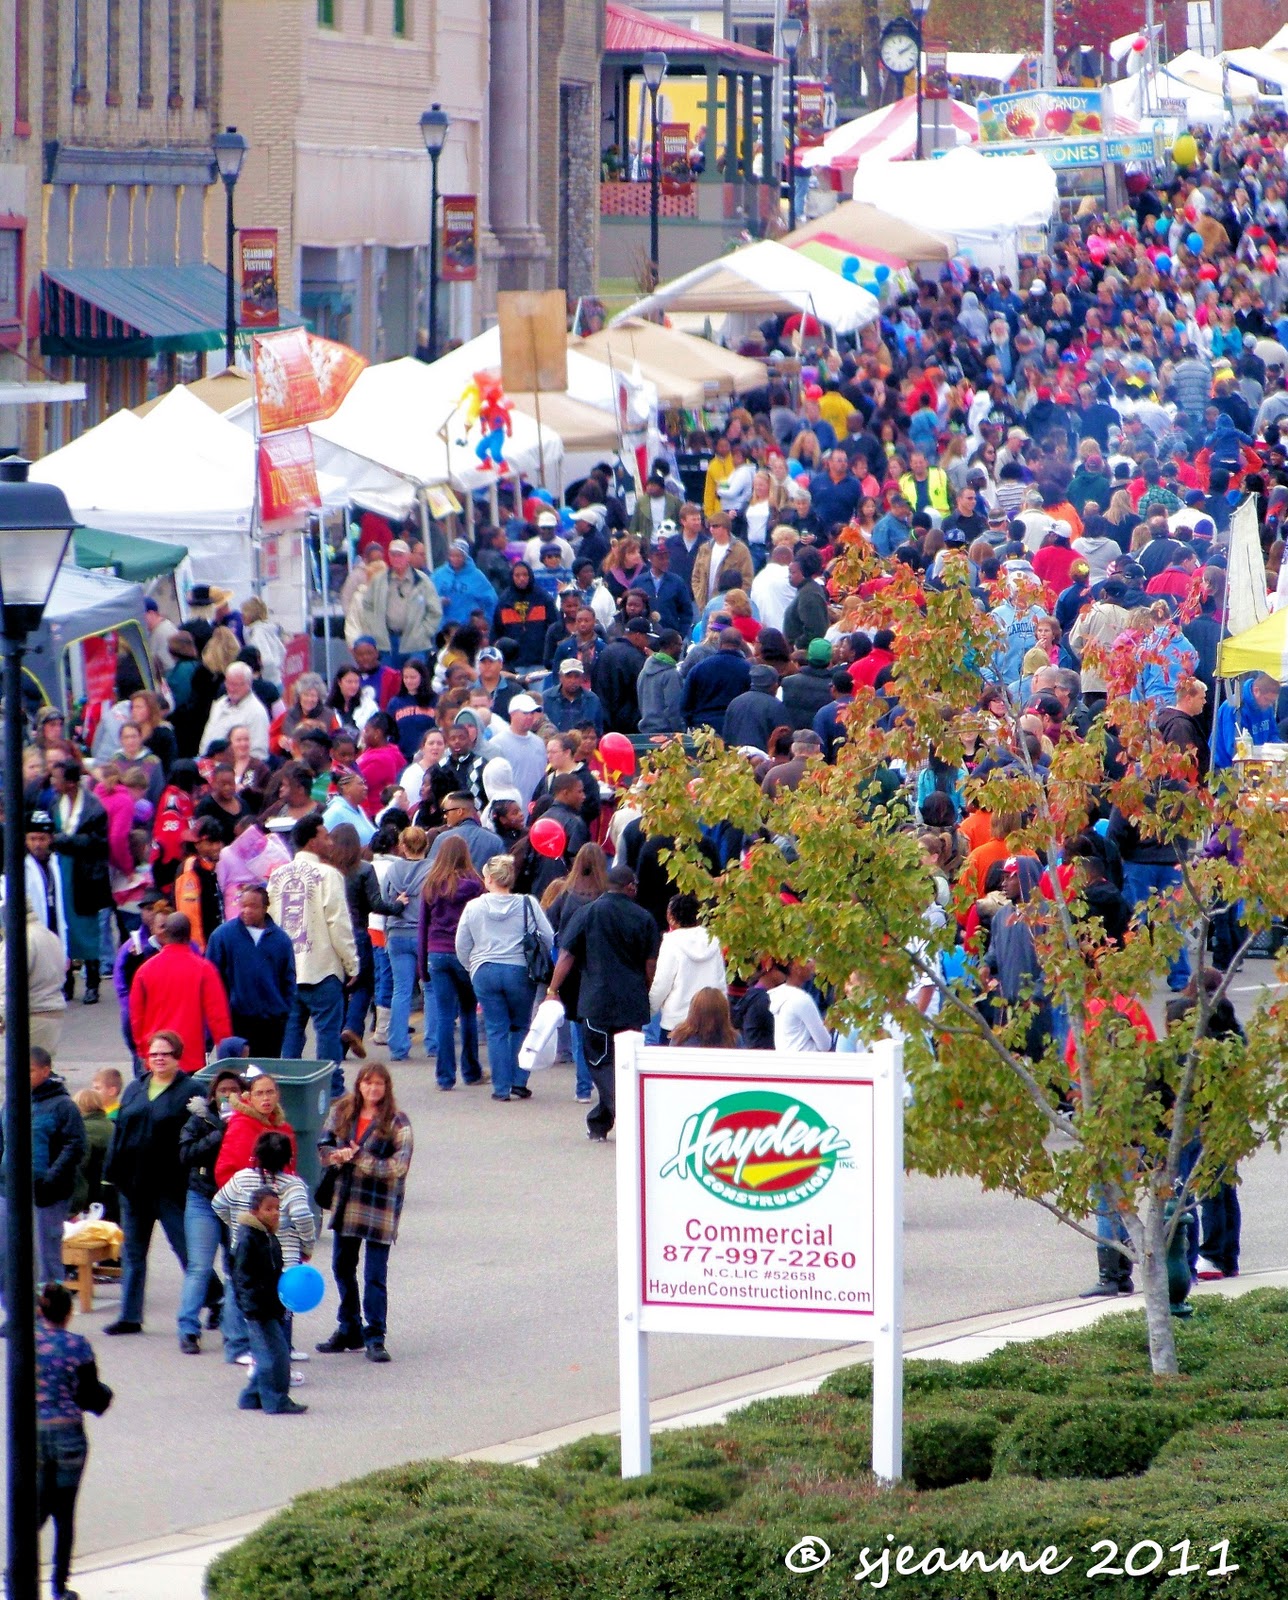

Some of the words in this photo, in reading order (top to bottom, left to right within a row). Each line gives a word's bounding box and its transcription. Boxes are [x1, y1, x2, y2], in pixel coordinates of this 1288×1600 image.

[1046, 96, 1088, 111] CANDY
[660, 1104, 851, 1184] Hayden
[702, 1165, 833, 1207] CONSTRUCTION
[685, 1218, 833, 1247] Commercial
[662, 1244, 857, 1270] 877-997-2260
[764, 1271, 816, 1282] #52658
[649, 1279, 871, 1303] HaydenConstructionInc.com
